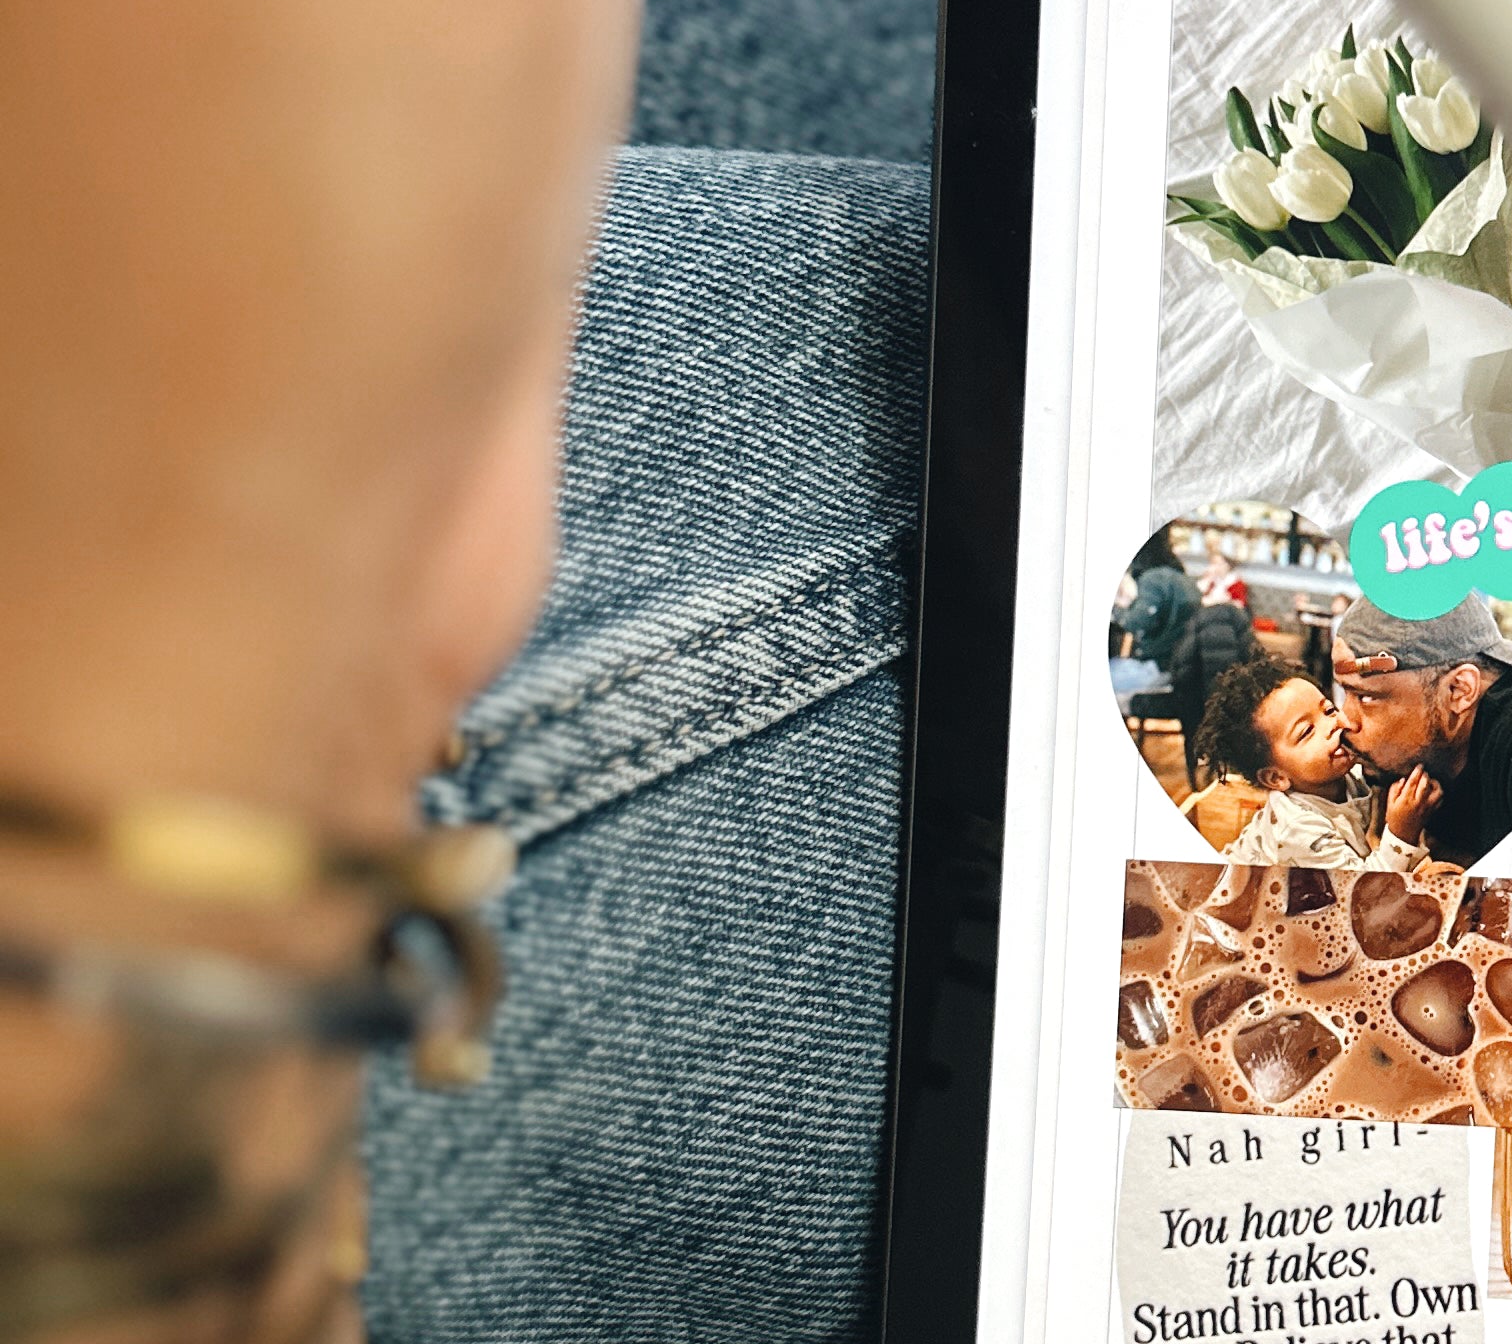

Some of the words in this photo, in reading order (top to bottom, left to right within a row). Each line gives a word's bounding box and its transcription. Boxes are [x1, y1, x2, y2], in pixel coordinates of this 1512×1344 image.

[1168, 1129, 1264, 1169] Nah
[1160, 1207, 1229, 1250] You
[1239, 1201, 1334, 1243] have
[1346, 1186, 1446, 1231] what
[1226, 1251, 1253, 1289] it
[1266, 1242, 1377, 1287] takes.
[1133, 1296, 1242, 1344] Stand
[1251, 1296, 1285, 1333] in
[1295, 1287, 1382, 1329] that.
[1391, 1277, 1480, 1318] Own
